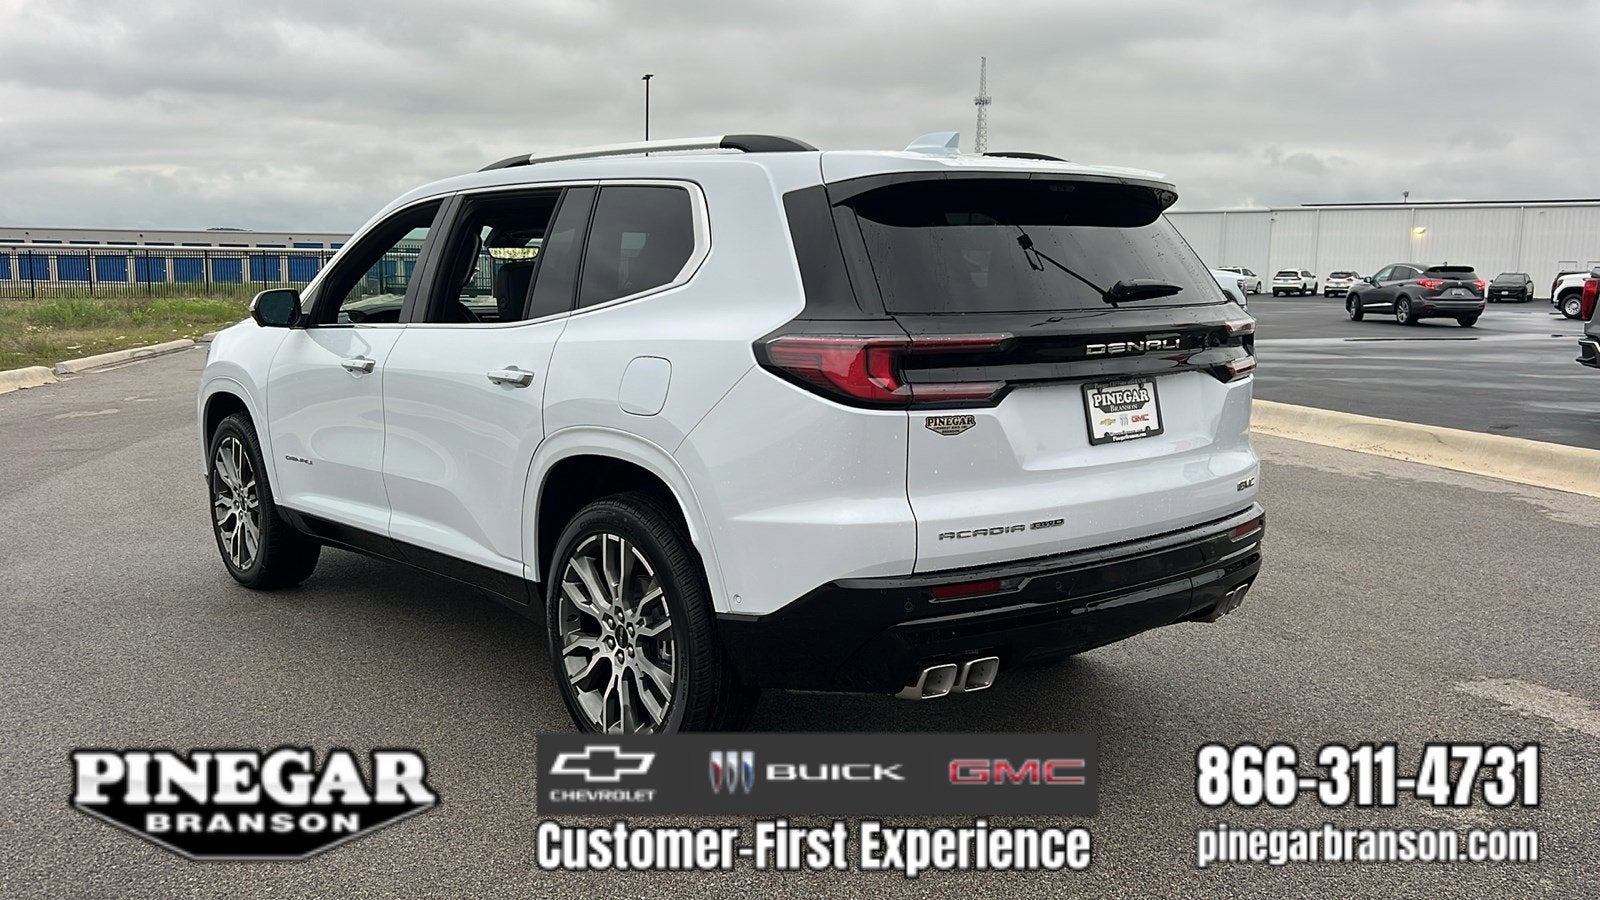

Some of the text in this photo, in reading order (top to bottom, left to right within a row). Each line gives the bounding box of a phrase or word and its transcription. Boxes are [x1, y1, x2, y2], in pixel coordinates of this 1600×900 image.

[1086, 338, 1181, 355] DENALI
[1093, 389, 1150, 407] PINEGAR
[1110, 404, 1138, 412] BRANSON
[927, 417, 974, 427] PINEGAR
[1131, 414, 1150, 423] GMC
[938, 524, 1025, 540] ACADIA
